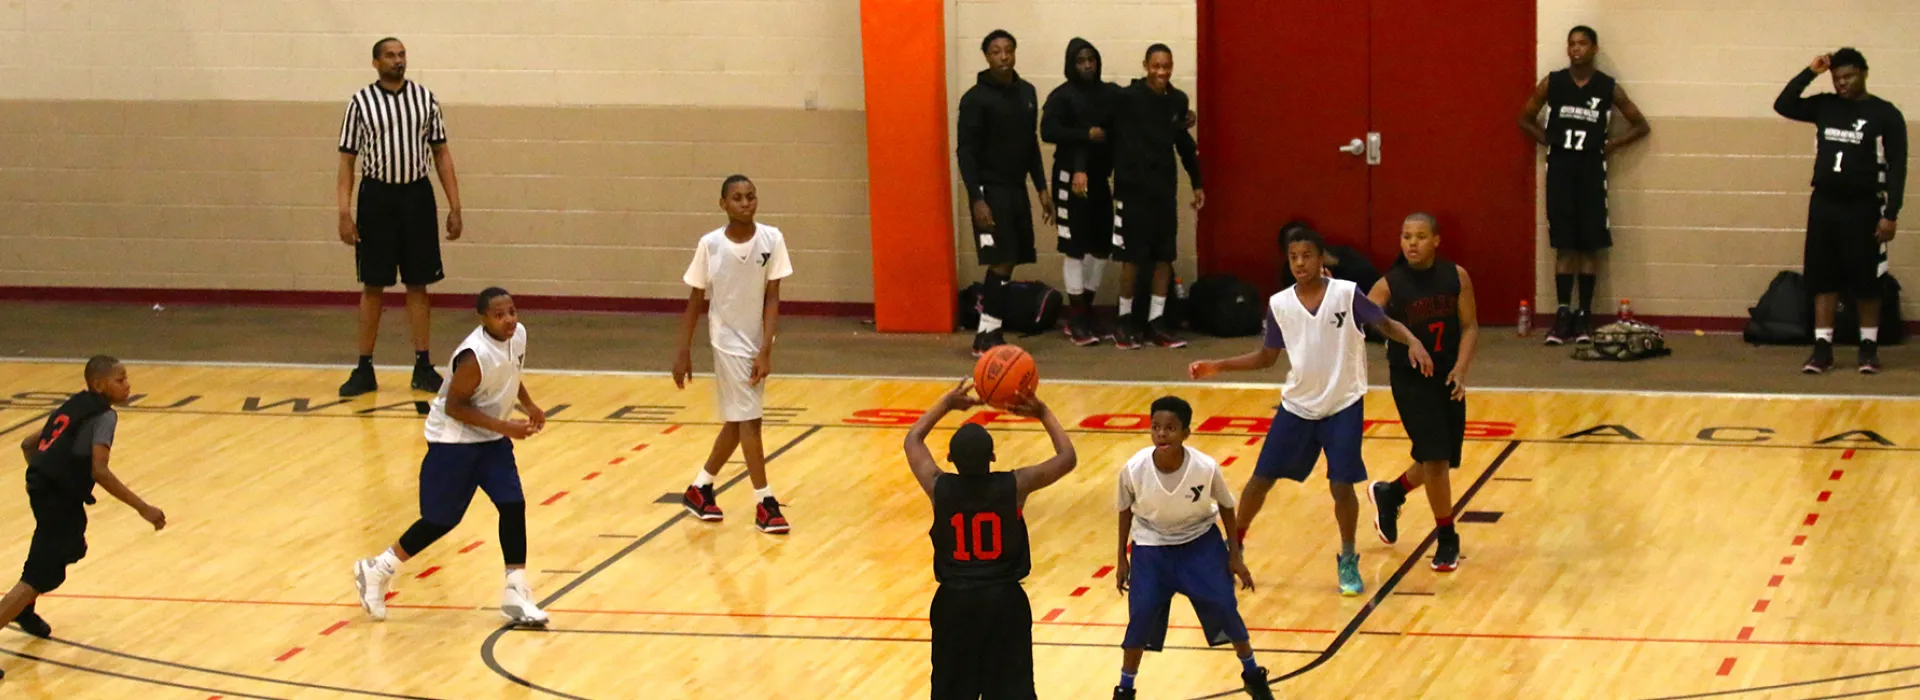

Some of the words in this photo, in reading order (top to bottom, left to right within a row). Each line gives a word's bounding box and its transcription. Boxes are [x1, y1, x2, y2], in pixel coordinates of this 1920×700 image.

[1563, 128, 1587, 150] 17
[1833, 151, 1843, 172] 1
[1428, 321, 1445, 352] 7
[38, 414, 71, 451] 3
[950, 511, 1002, 561] 10
